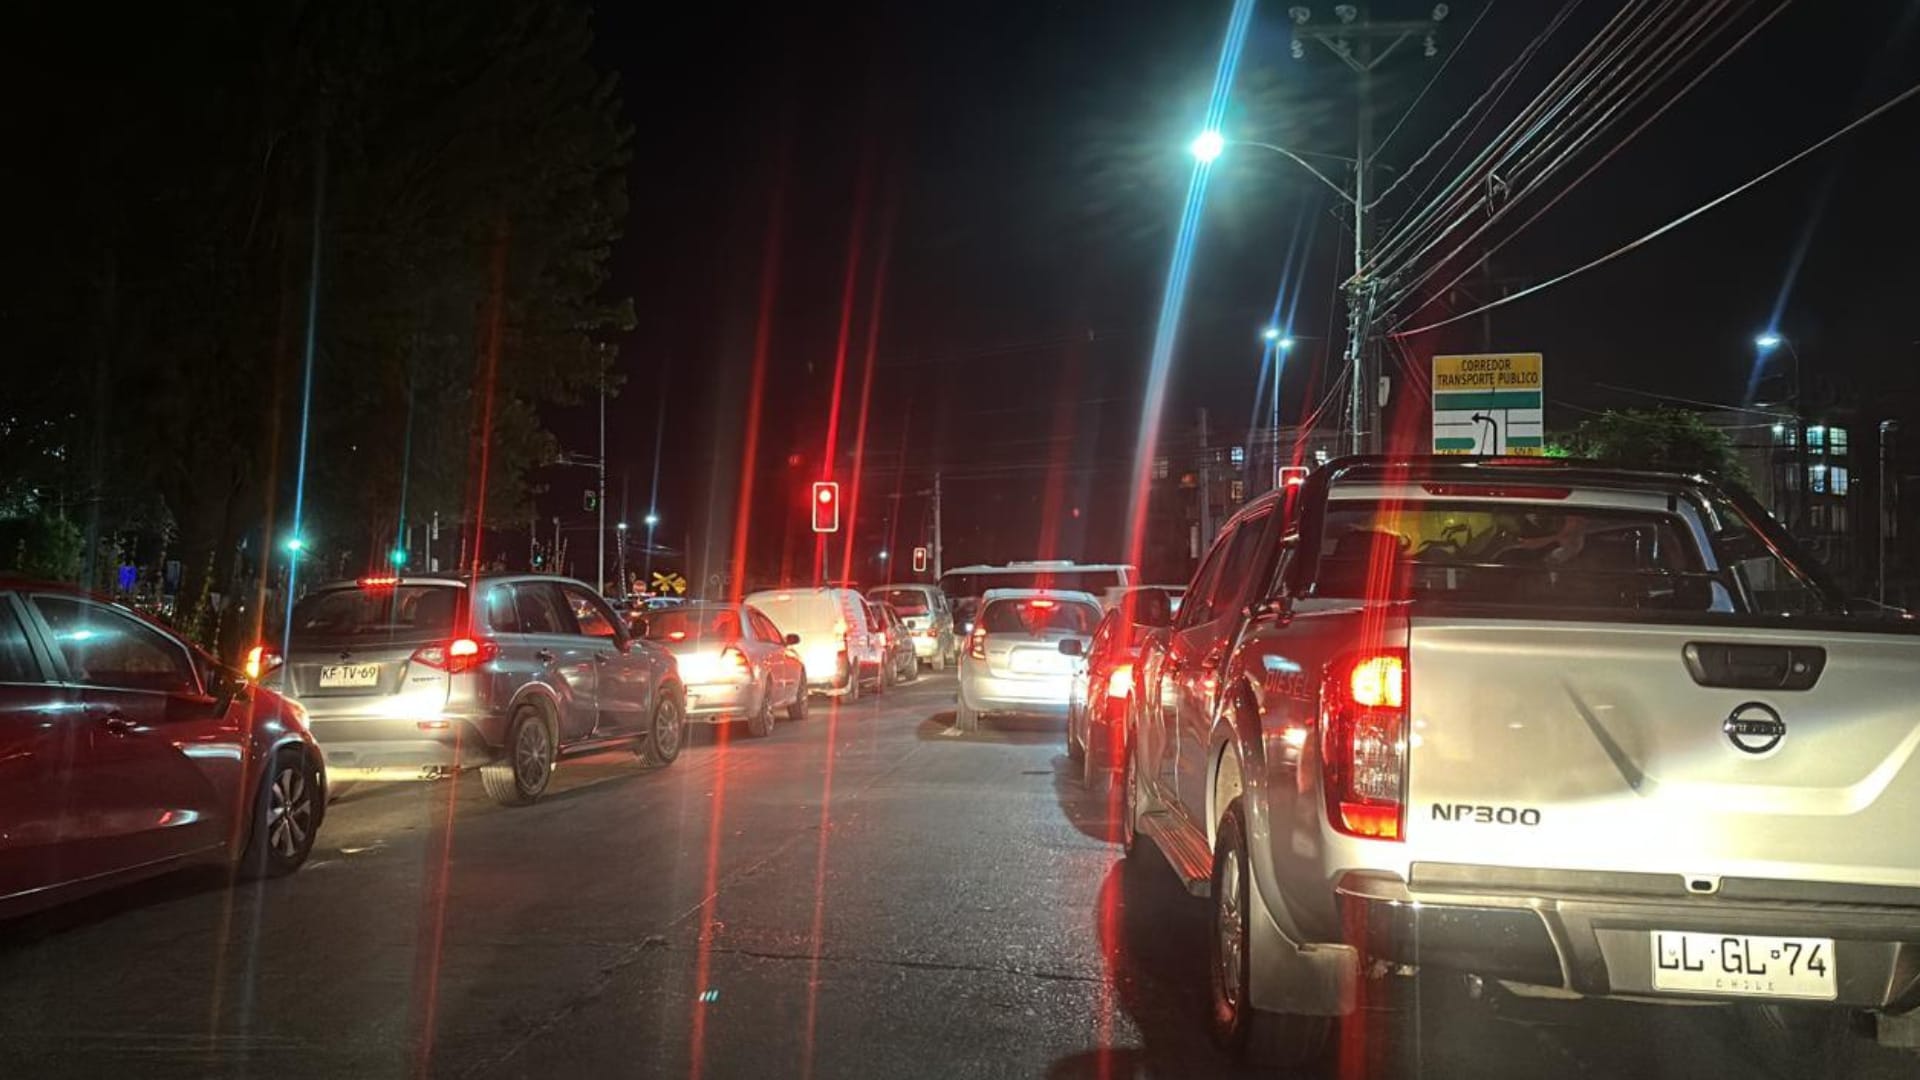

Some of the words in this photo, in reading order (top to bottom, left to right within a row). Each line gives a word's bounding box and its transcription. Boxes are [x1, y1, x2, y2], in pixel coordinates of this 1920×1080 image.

[1461, 359, 1512, 371] CORREDOR
[1438, 373, 1495, 385] TRANSPORTE
[1431, 803, 1541, 825] NP300
